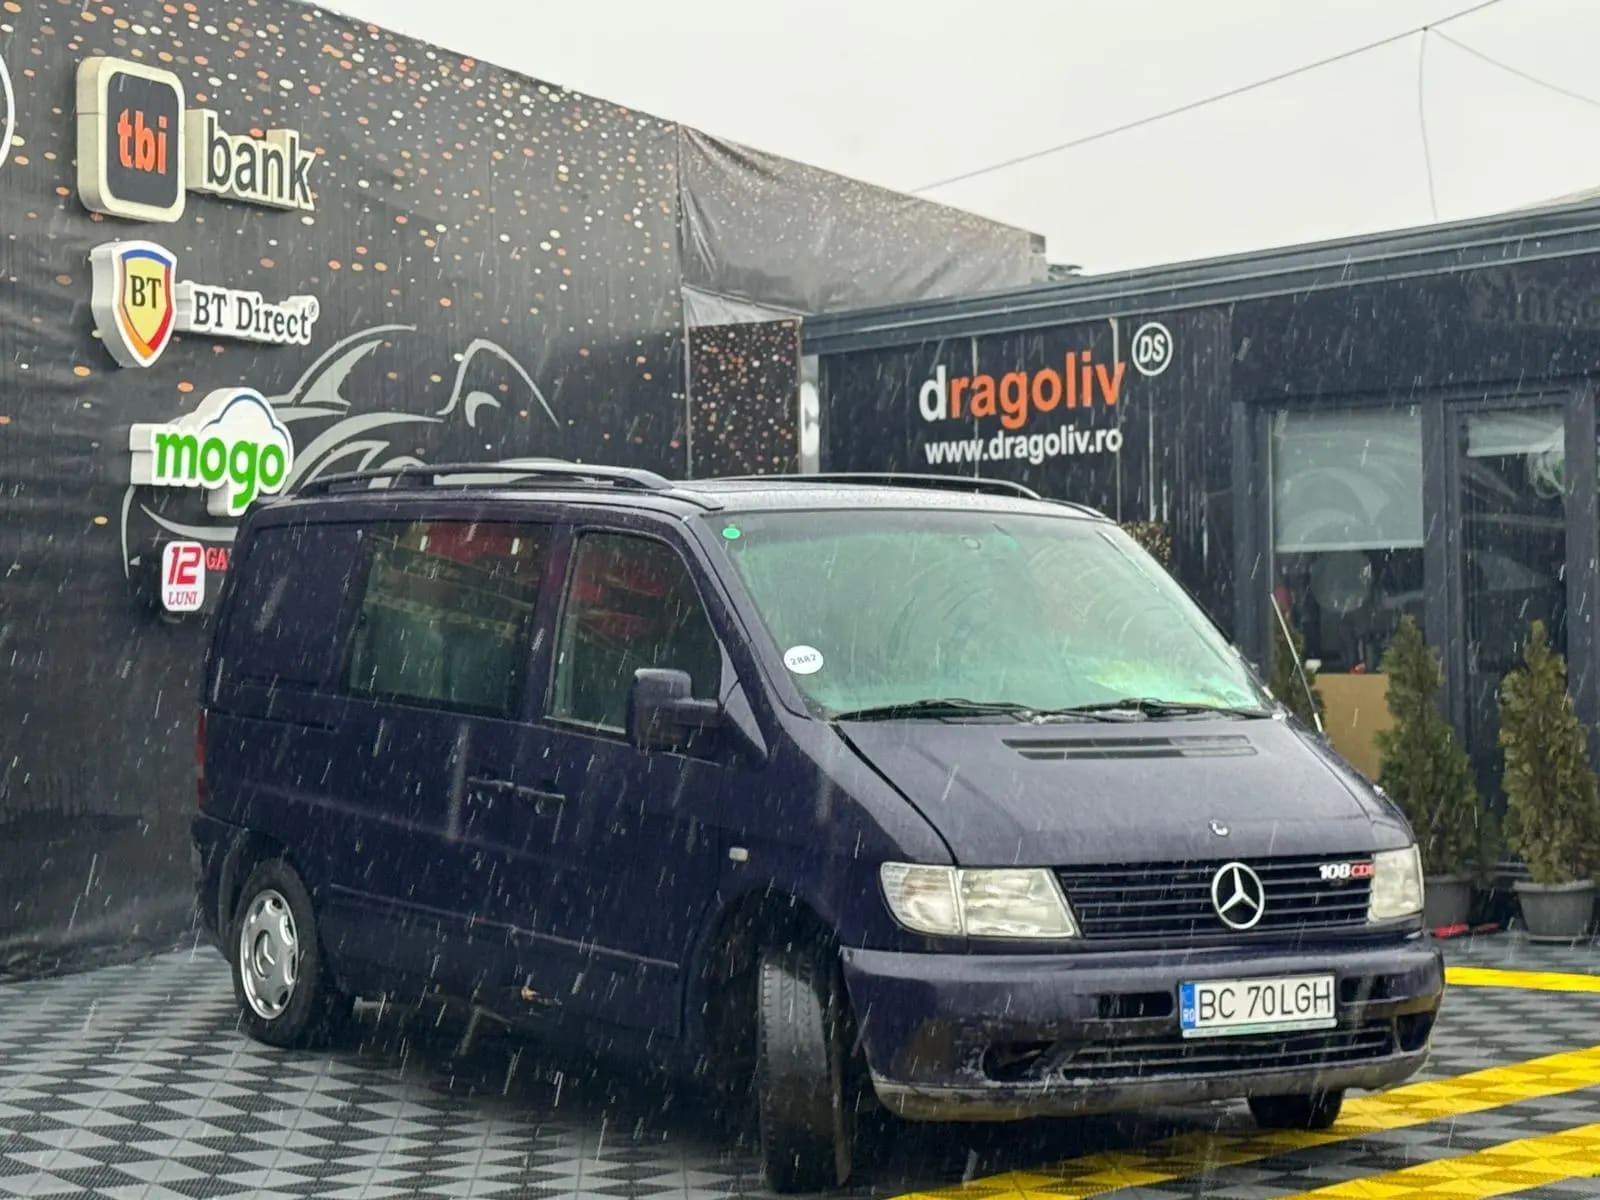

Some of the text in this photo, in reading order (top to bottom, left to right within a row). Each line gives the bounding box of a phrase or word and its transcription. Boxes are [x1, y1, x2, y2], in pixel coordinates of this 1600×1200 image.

[117, 108, 168, 175] tbi
[206, 117, 315, 205] bank
[130, 275, 162, 309] BT
[194, 290, 228, 328] BT
[1138, 334, 1166, 363] DS
[919, 350, 1126, 429] dragoliv
[925, 425, 1123, 465] www.dragoliv.ro
[155, 433, 285, 509] mogo
[167, 546, 232, 586] 12 GA
[167, 591, 198, 606] LUNI
[1199, 988, 1236, 1021] BC
